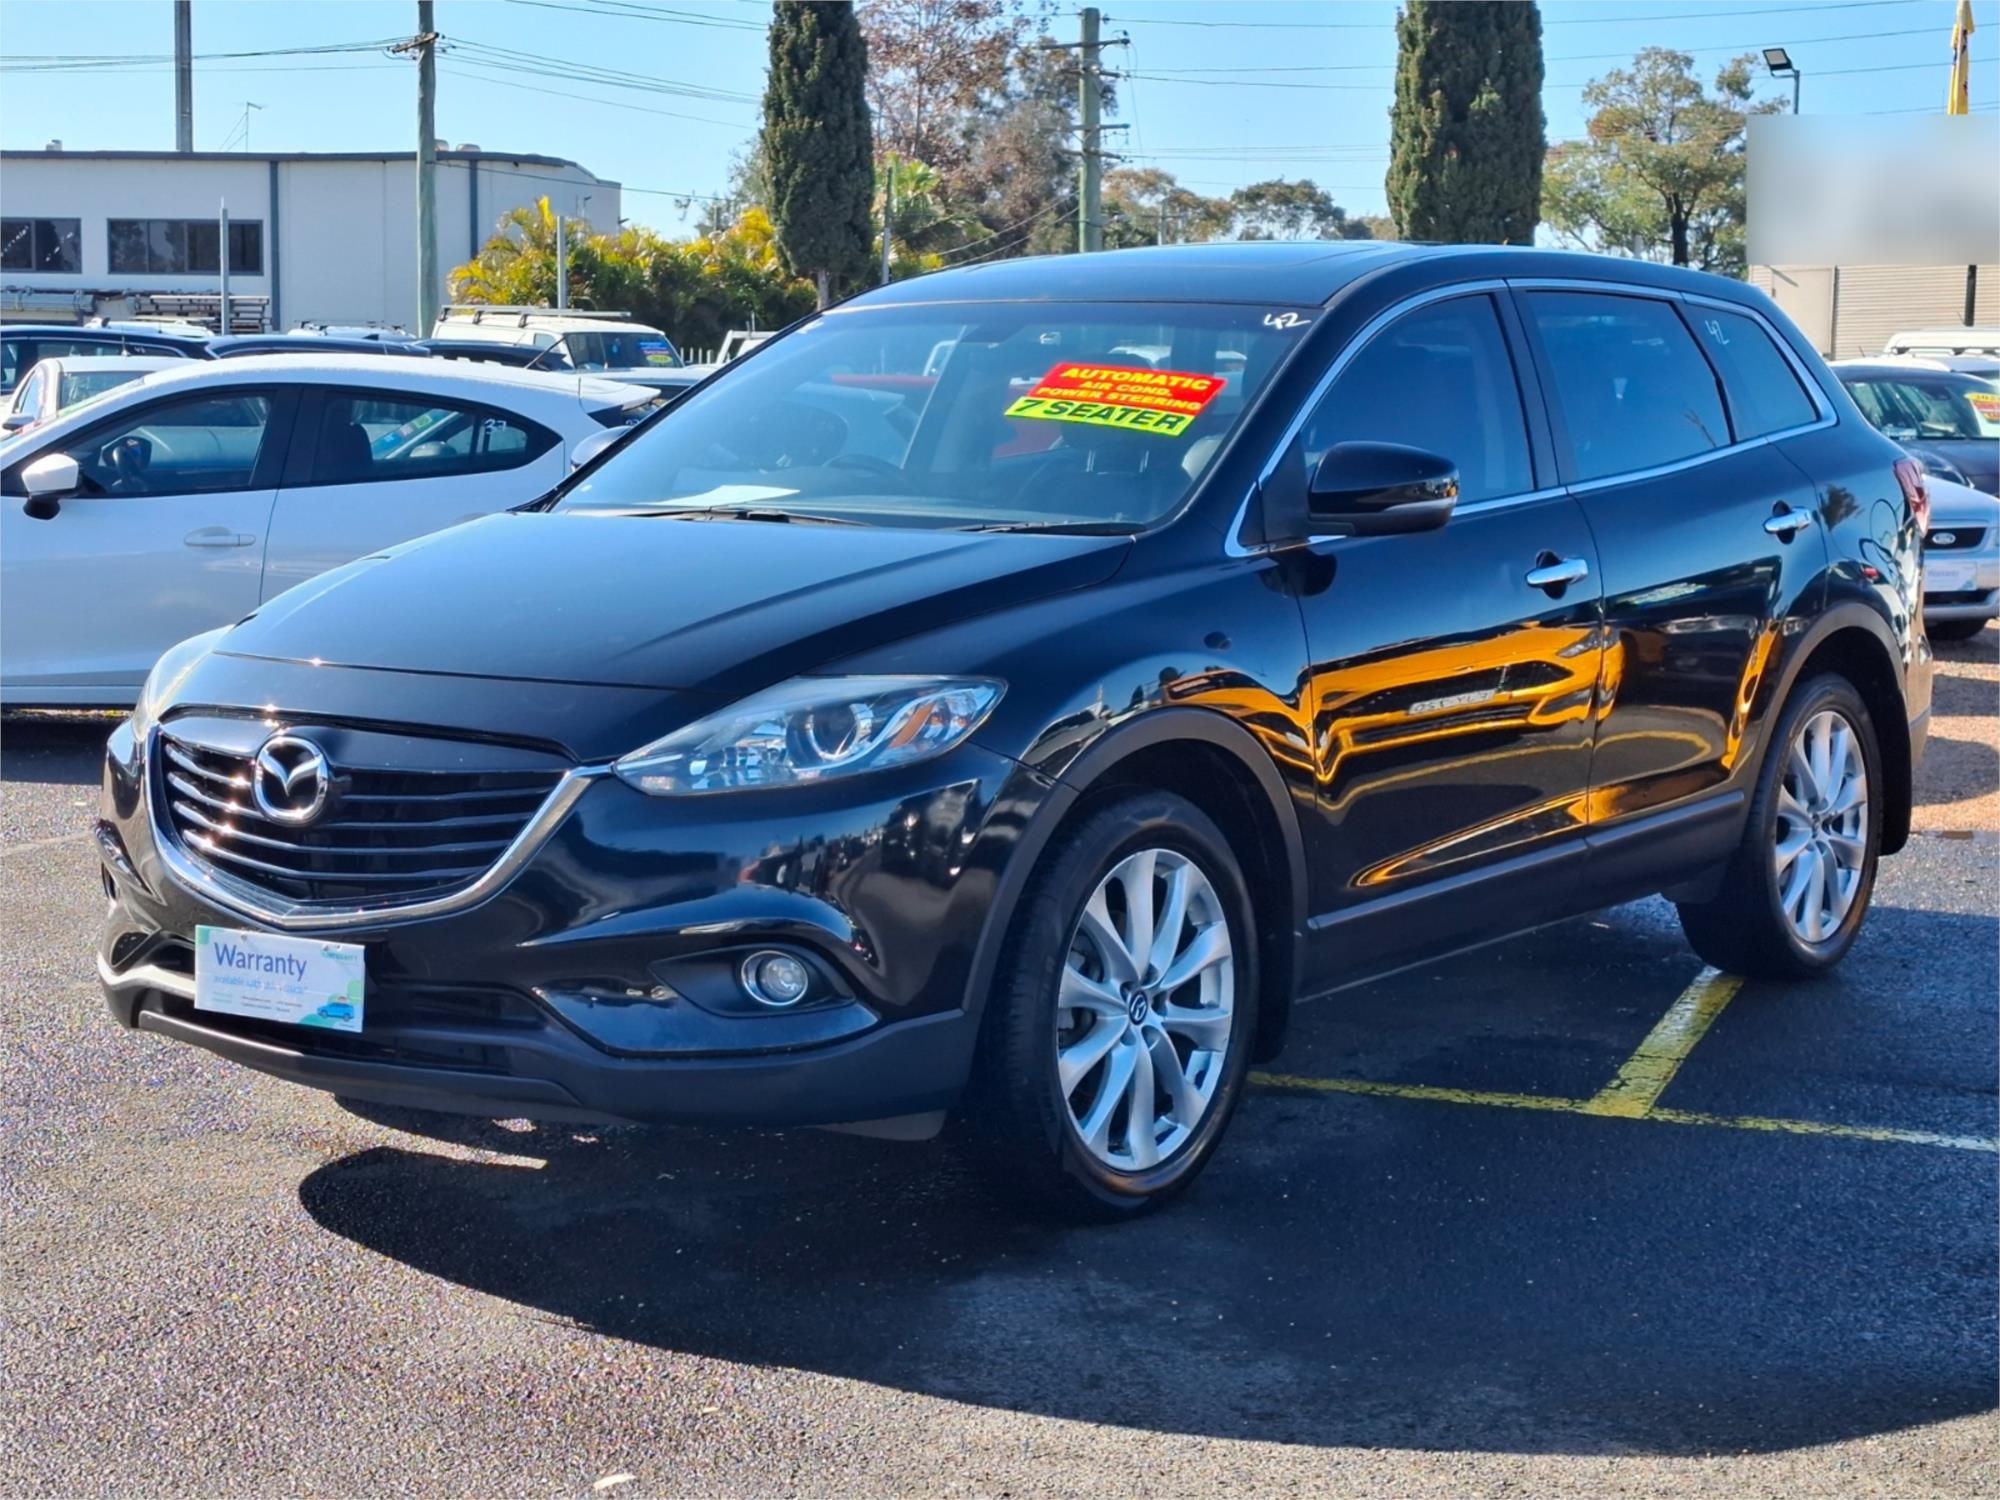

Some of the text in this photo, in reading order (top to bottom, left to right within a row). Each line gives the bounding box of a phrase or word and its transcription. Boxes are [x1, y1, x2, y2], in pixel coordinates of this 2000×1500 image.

[1263, 312, 1312, 330] 42
[1060, 367, 1212, 391] AUTOMATIC
[1079, 380, 1173, 397] AIR COND.
[1036, 387, 1203, 411] POWER STEERING
[1014, 399, 1186, 430] 7 SEATER
[214, 942, 307, 982] Warranty
